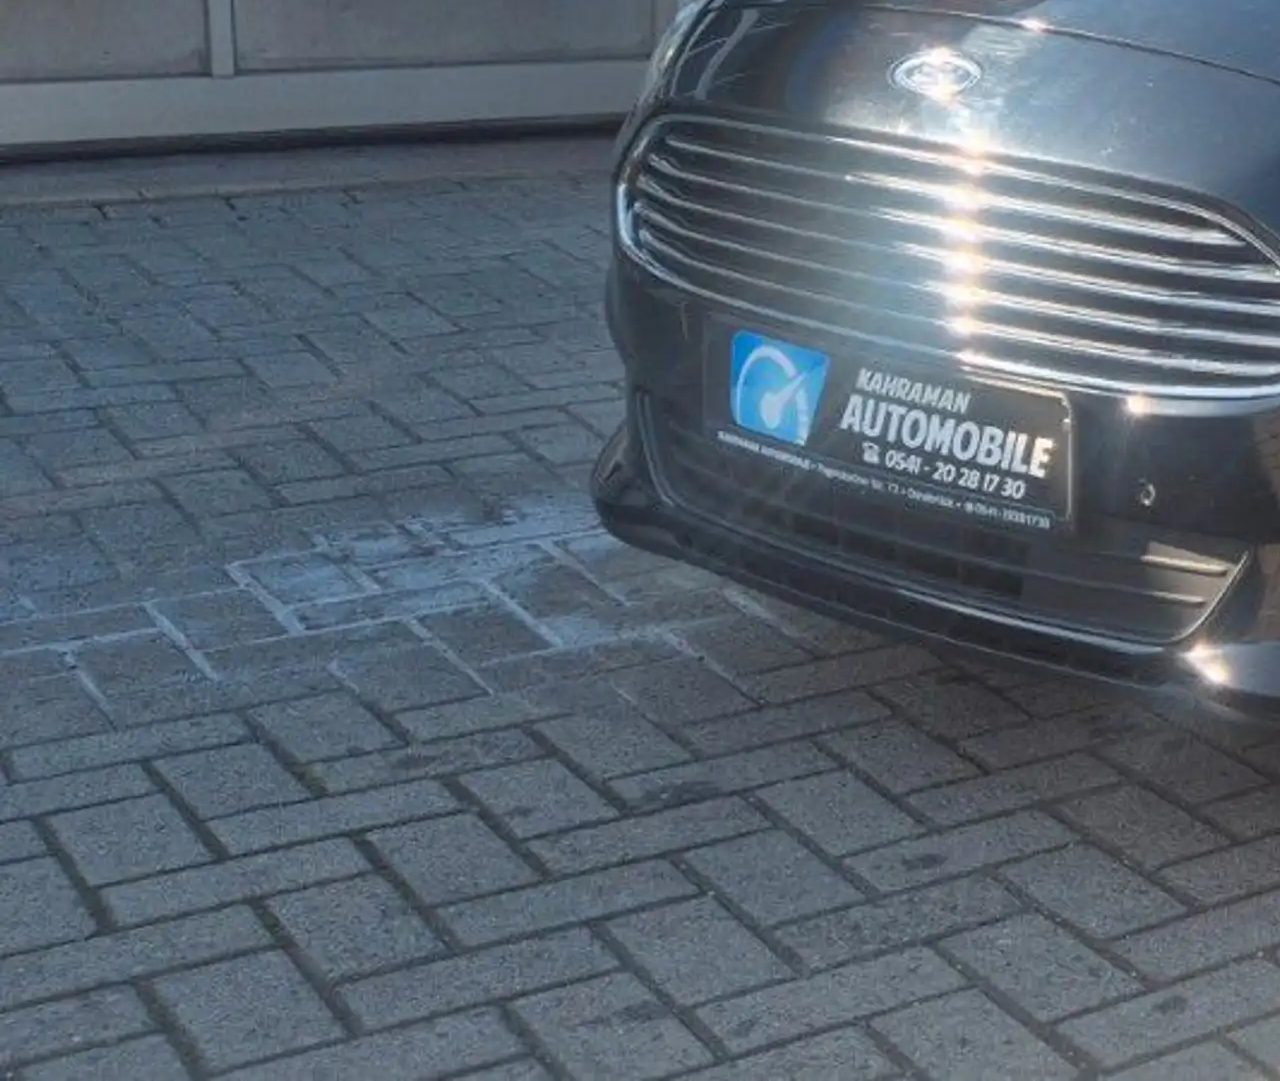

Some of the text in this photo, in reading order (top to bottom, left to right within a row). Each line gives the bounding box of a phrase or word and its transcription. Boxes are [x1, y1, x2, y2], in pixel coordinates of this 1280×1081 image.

[855, 368, 971, 414] KAHRAMAN
[840, 393, 1055, 479] AUTOMOBILE
[885, 450, 923, 475] 0541
[932, 462, 956, 483] 20
[958, 467, 981, 489] 28
[983, 473, 1000, 492] 17
[1001, 478, 1026, 499] 30
